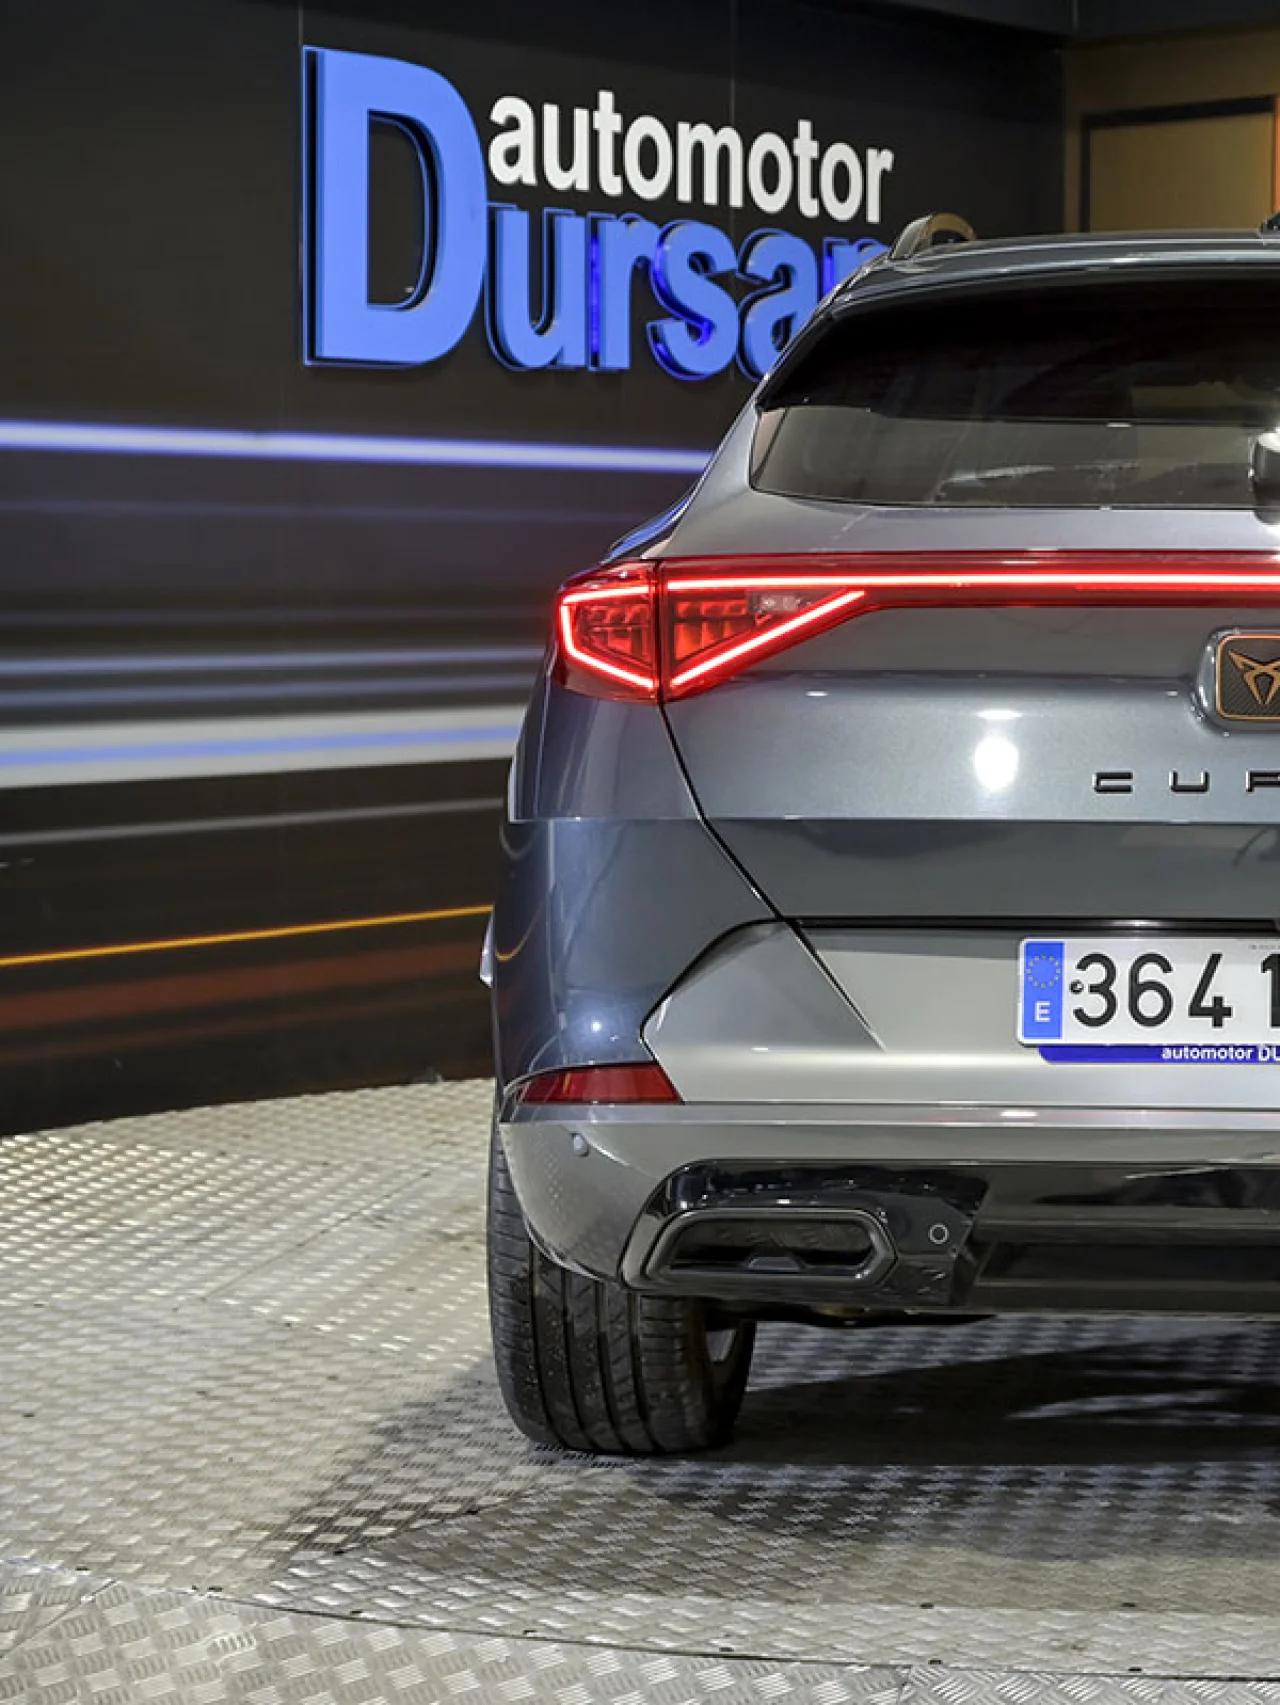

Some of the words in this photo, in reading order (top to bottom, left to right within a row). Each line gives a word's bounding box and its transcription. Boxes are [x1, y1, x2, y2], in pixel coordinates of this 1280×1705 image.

[489, 90, 893, 223] automotor
[1035, 1002, 1050, 1022] E
[1162, 1046, 1253, 1060] automotor
